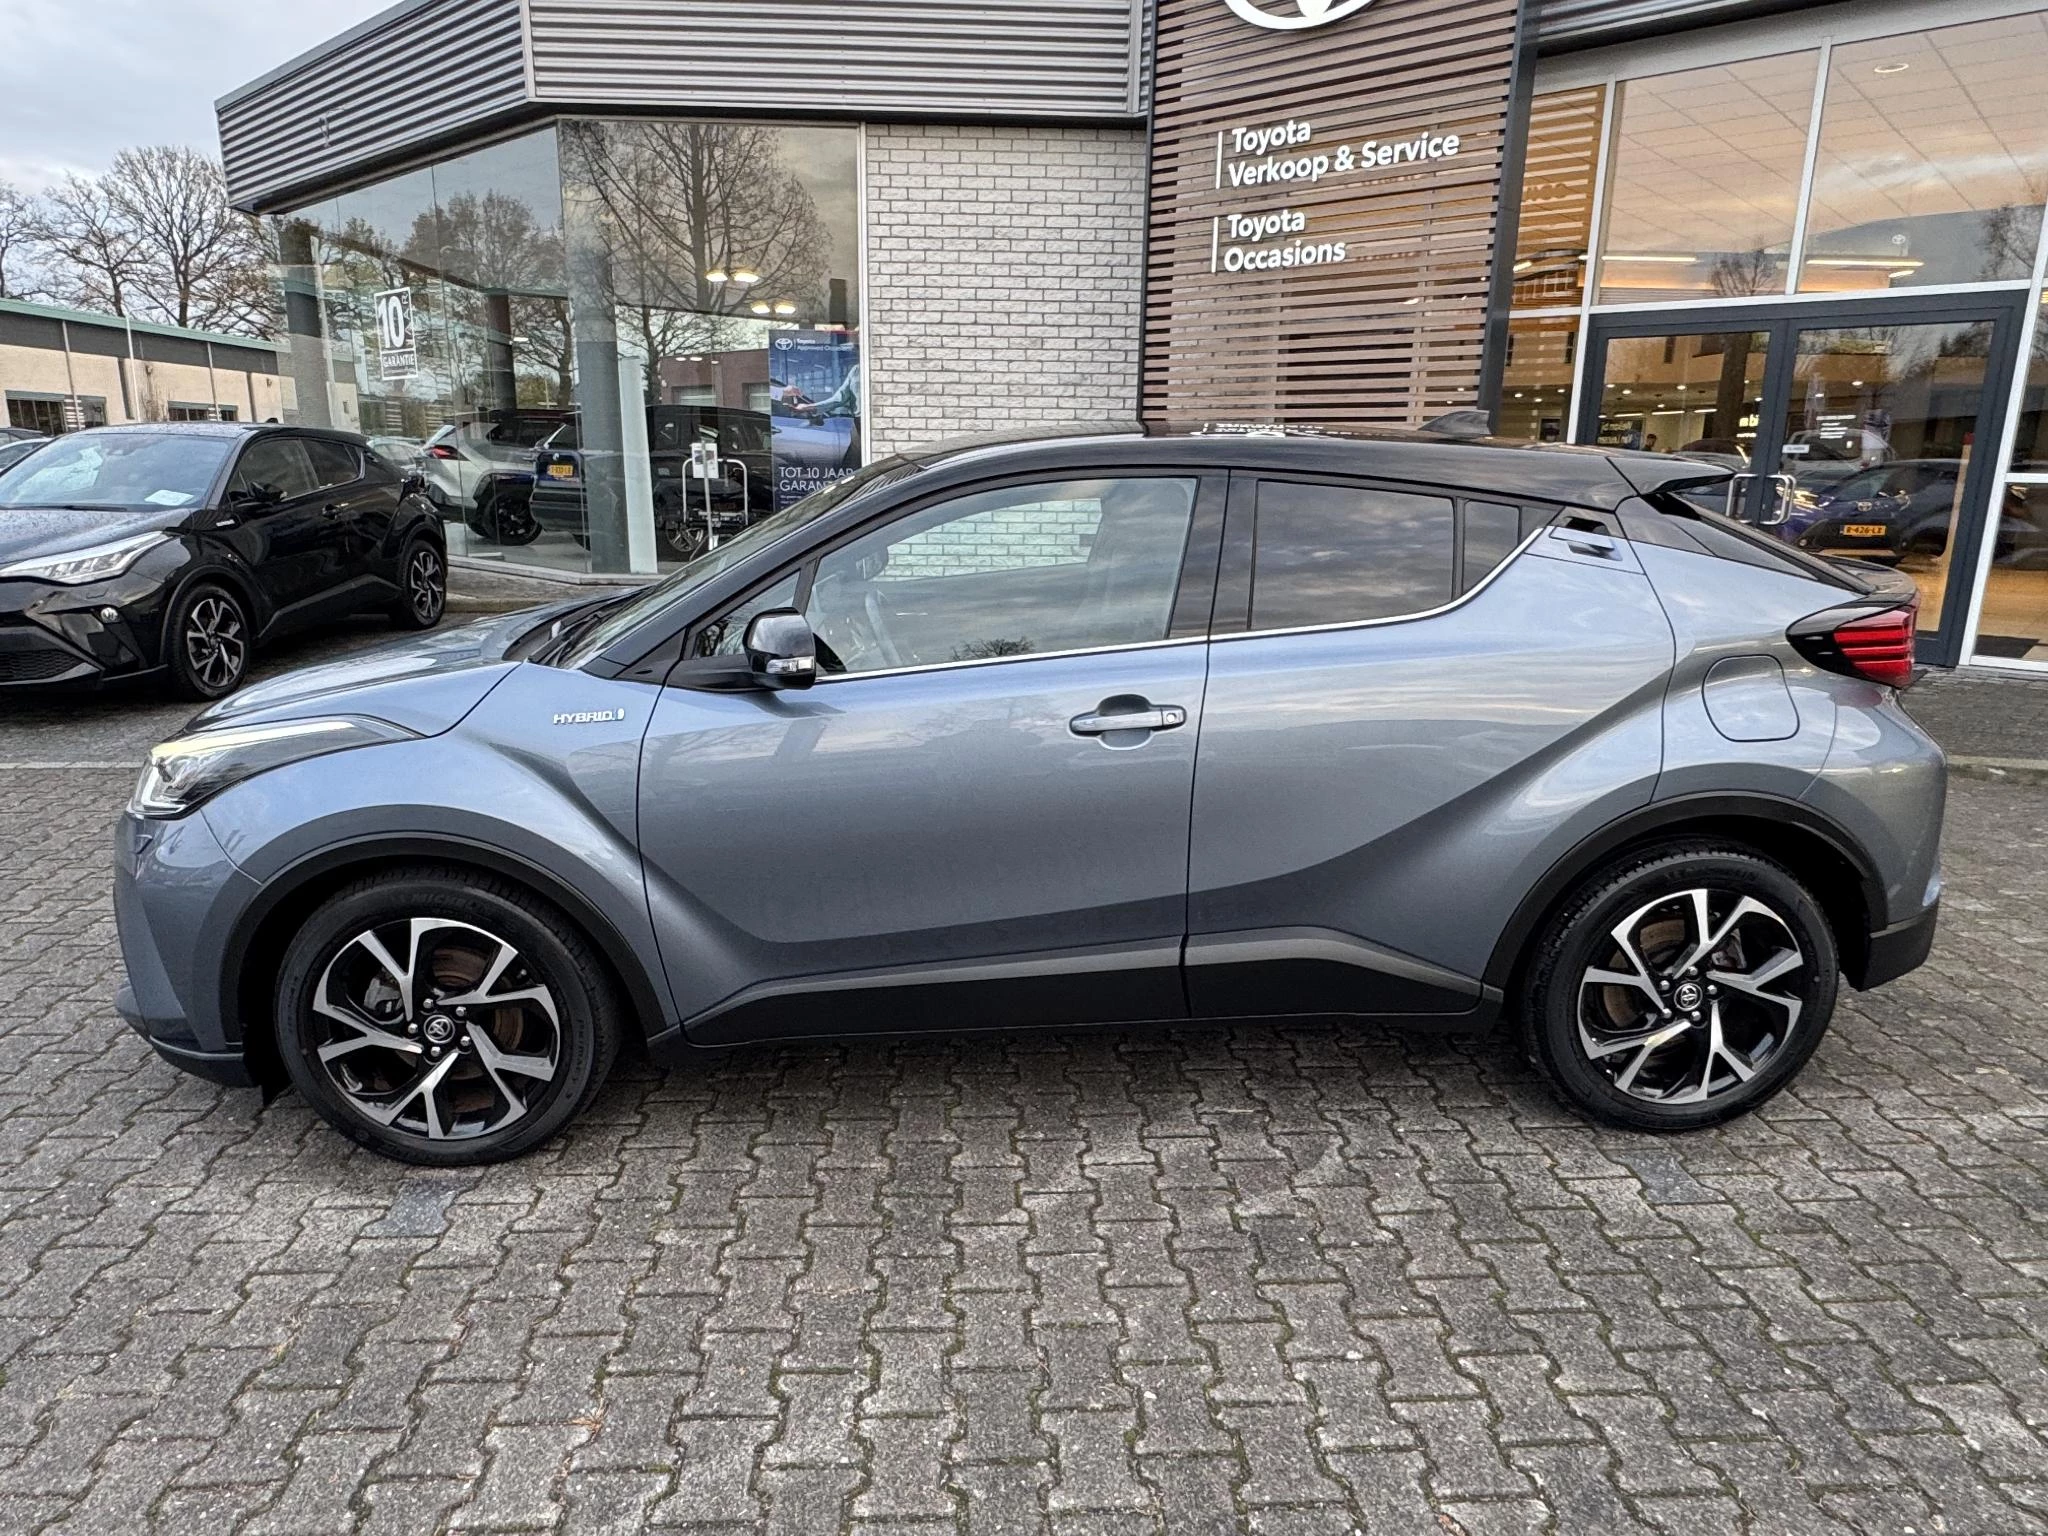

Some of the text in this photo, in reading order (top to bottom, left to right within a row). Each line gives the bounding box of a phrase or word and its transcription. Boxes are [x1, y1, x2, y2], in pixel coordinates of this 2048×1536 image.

[1231, 119, 1311, 156] Toyota
[1228, 131, 1460, 187] Verkoop & Service
[1227, 209, 1306, 242] Toyota
[1223, 240, 1346, 272] Occasions
[378, 295, 404, 348] 10
[383, 354, 414, 368] GARANTIE
[778, 466, 802, 479] TOT
[806, 467, 820, 479] 10
[553, 710, 613, 724] HYBRID
